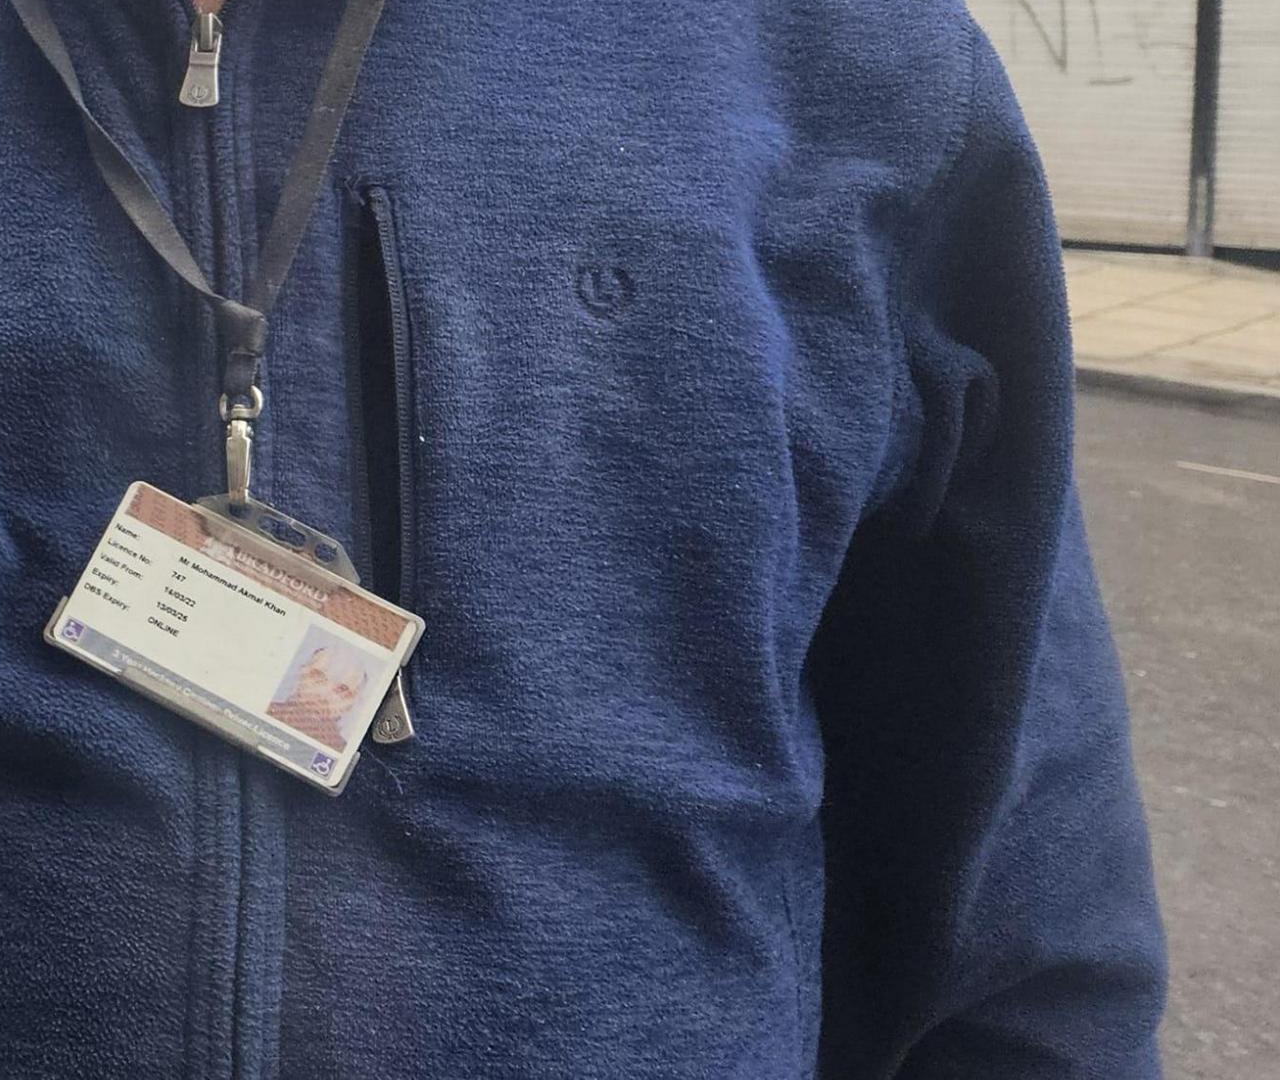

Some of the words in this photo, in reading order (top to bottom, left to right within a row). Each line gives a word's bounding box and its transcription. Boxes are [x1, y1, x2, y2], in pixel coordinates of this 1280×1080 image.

[116, 524, 141, 540] Name:
[108, 538, 136, 557] Licence
[100, 553, 120, 567] Valid
[120, 563, 145, 580] From:
[92, 568, 121, 587] Expiry:
[172, 571, 187, 582] 747
[84, 583, 102, 596] DBS
[103, 592, 132, 612] Expiry:
[192, 563, 239, 591] Mohammad
[239, 588, 264, 604] Akmal
[265, 601, 288, 616] Khan
[148, 616, 181, 636] ONLINE
